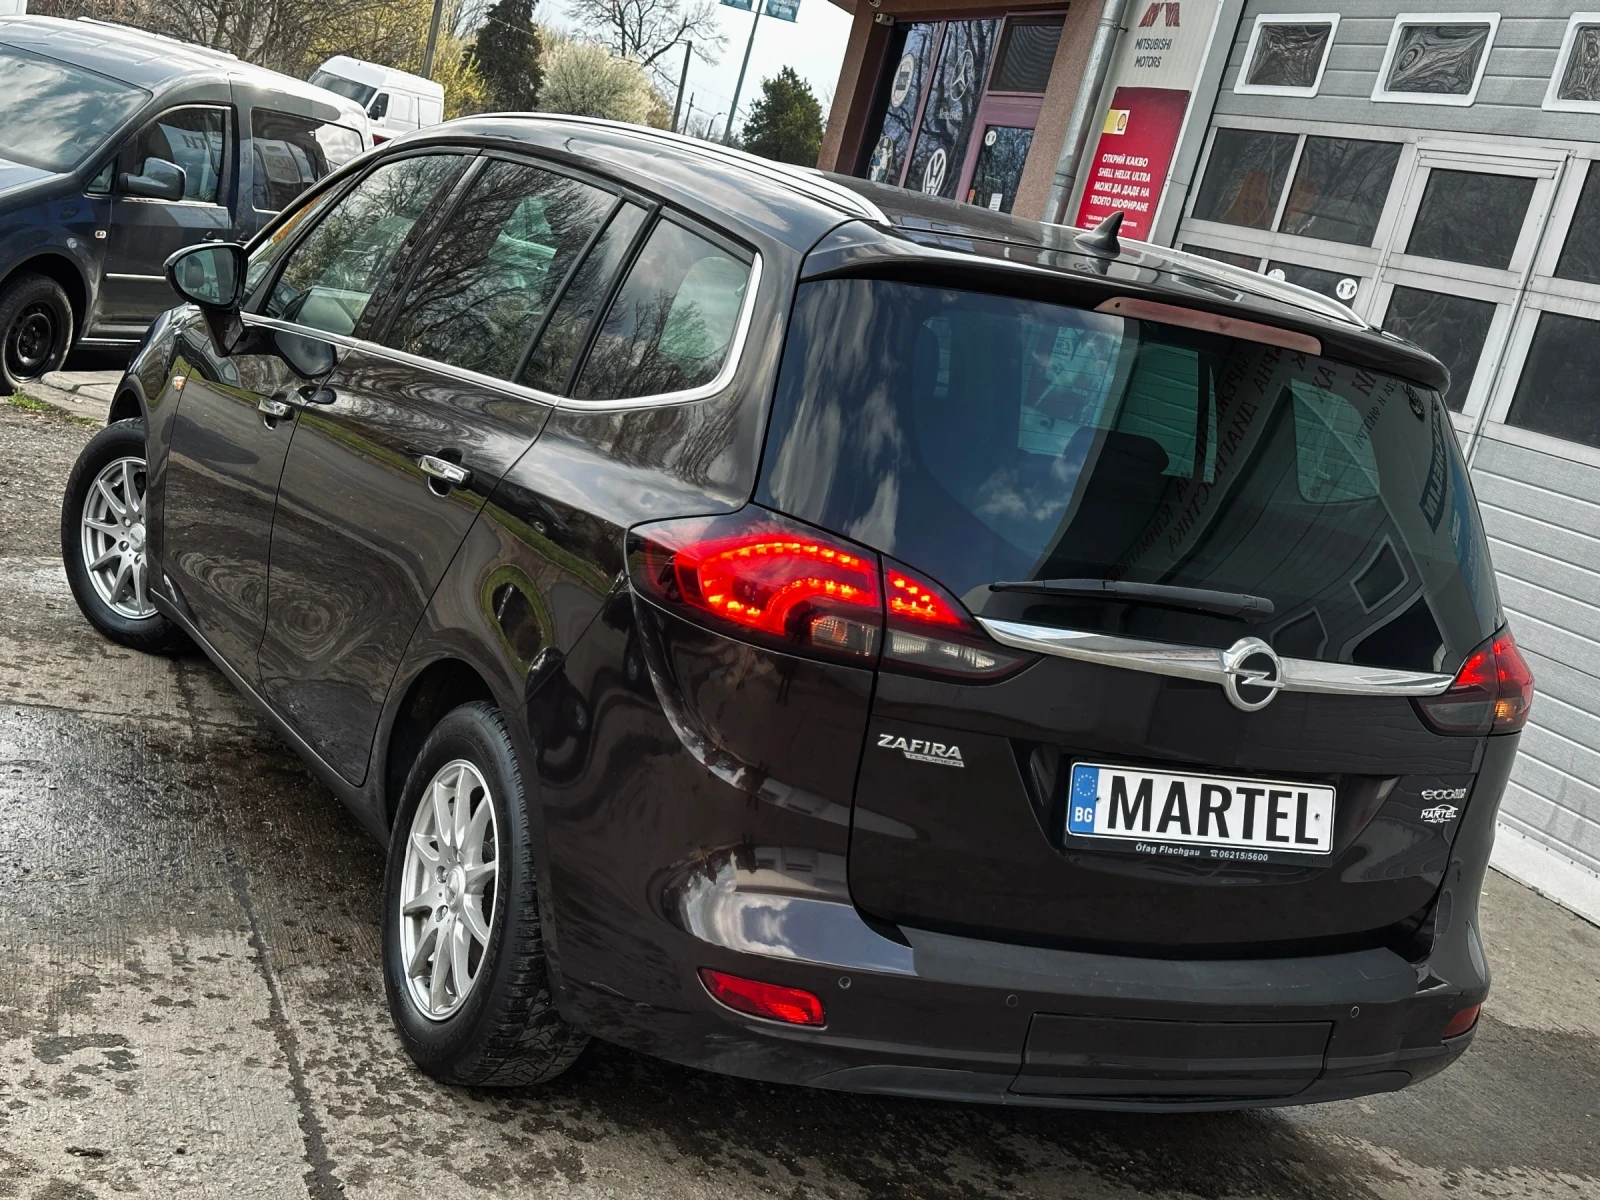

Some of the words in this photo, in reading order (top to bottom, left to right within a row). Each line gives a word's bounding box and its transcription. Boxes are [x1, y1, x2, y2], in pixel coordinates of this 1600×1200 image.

[1135, 38, 1173, 50] MITSUBISHI
[1134, 56, 1162, 68] MOTORS
[1102, 153, 1126, 165] ОТКРИЙ
[1126, 156, 1149, 168] КАКВО
[1098, 167, 1114, 178] SHELL
[1114, 169, 1132, 180] HELIX
[1131, 171, 1151, 182] ULTRA
[1094, 181, 1113, 192] МОЖЕ
[1112, 183, 1122, 194] ДА
[1121, 185, 1141, 197] ДАДЕ
[1140, 187, 1150, 198] НА
[1090, 195, 1112, 207] ТВОЕТО
[1111, 198, 1149, 212] ШОФИРАНЕ
[877, 733, 962, 760] ZAFIRA
[1074, 806, 1093, 823] BG
[1107, 775, 1319, 845] MARTEL
[1420, 809, 1457, 819] MARTEL
[1135, 842, 1156, 854] Öfag
[1159, 845, 1200, 857] Flachgau
[1219, 850, 1268, 861] 06215/5600
